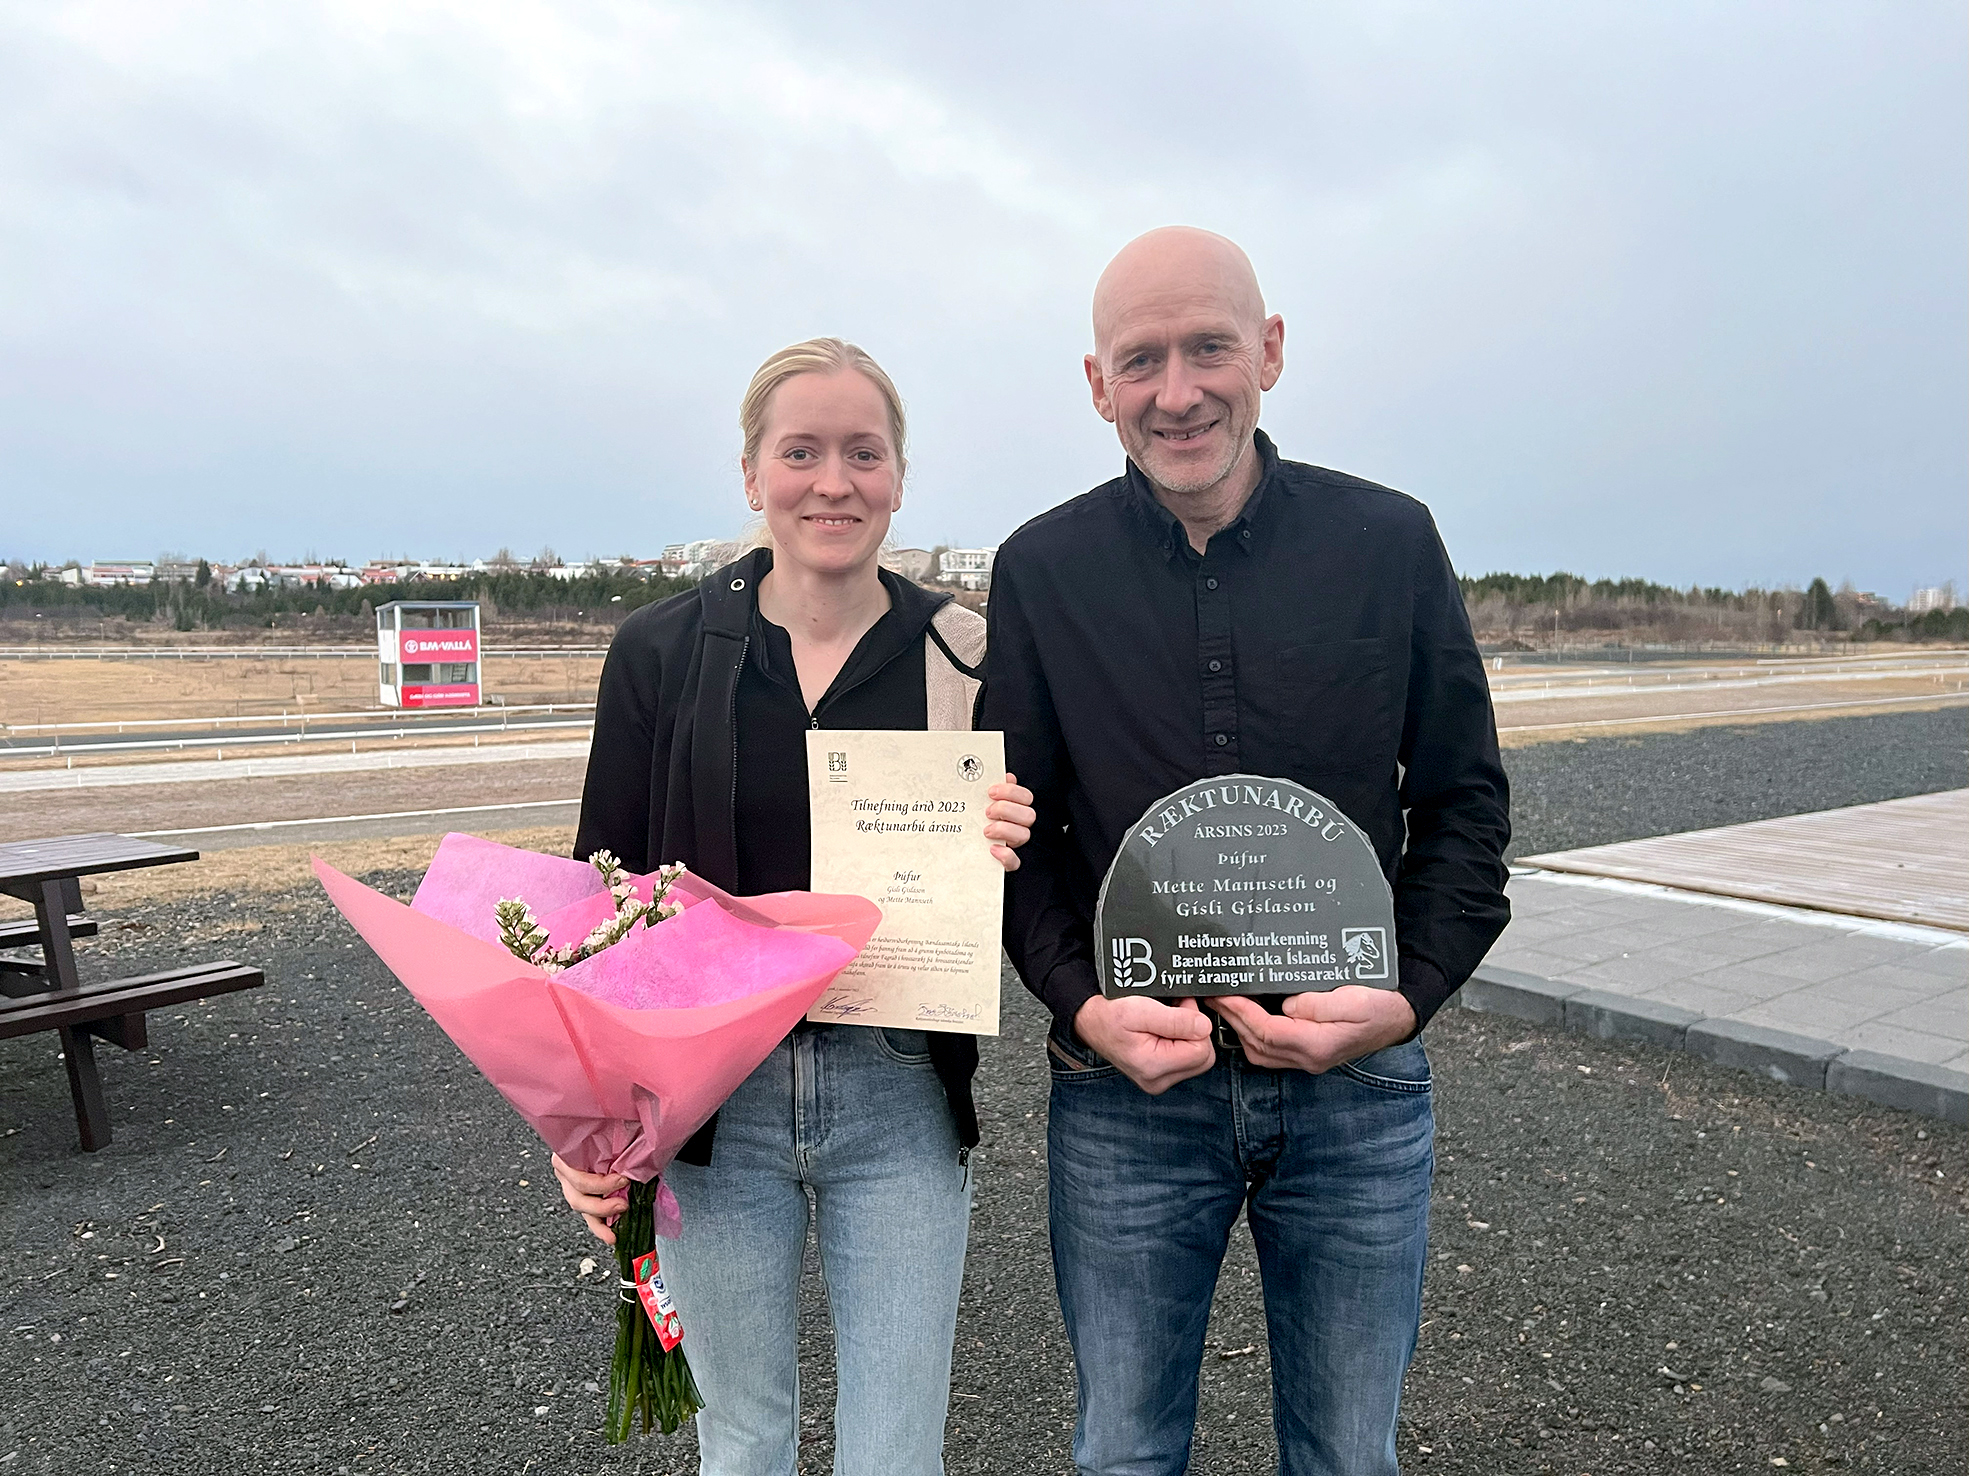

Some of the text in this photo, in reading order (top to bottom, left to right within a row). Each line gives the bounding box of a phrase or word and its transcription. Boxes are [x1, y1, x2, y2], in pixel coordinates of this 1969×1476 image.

[851, 799, 966, 816] Tilnefning árið 2023
[1139, 785, 1345, 847] RÆKTUNARBÚ
[856, 818, 962, 834] Ræktunarbú ársins
[1194, 823, 1288, 838] ÁRSINS 2023
[1218, 851, 1267, 869] Þúfur
[893, 870, 922, 884] Þúfur
[1152, 874, 1337, 894] Mette Mannseth og
[1176, 898, 1316, 917] Gísli Gíslason
[1178, 931, 1328, 949] Heiðursviðurkenning
[1172, 948, 1337, 969] Bændasamtaka Íslands
[1161, 966, 1350, 989] fyrir árangur í hrossarækt
